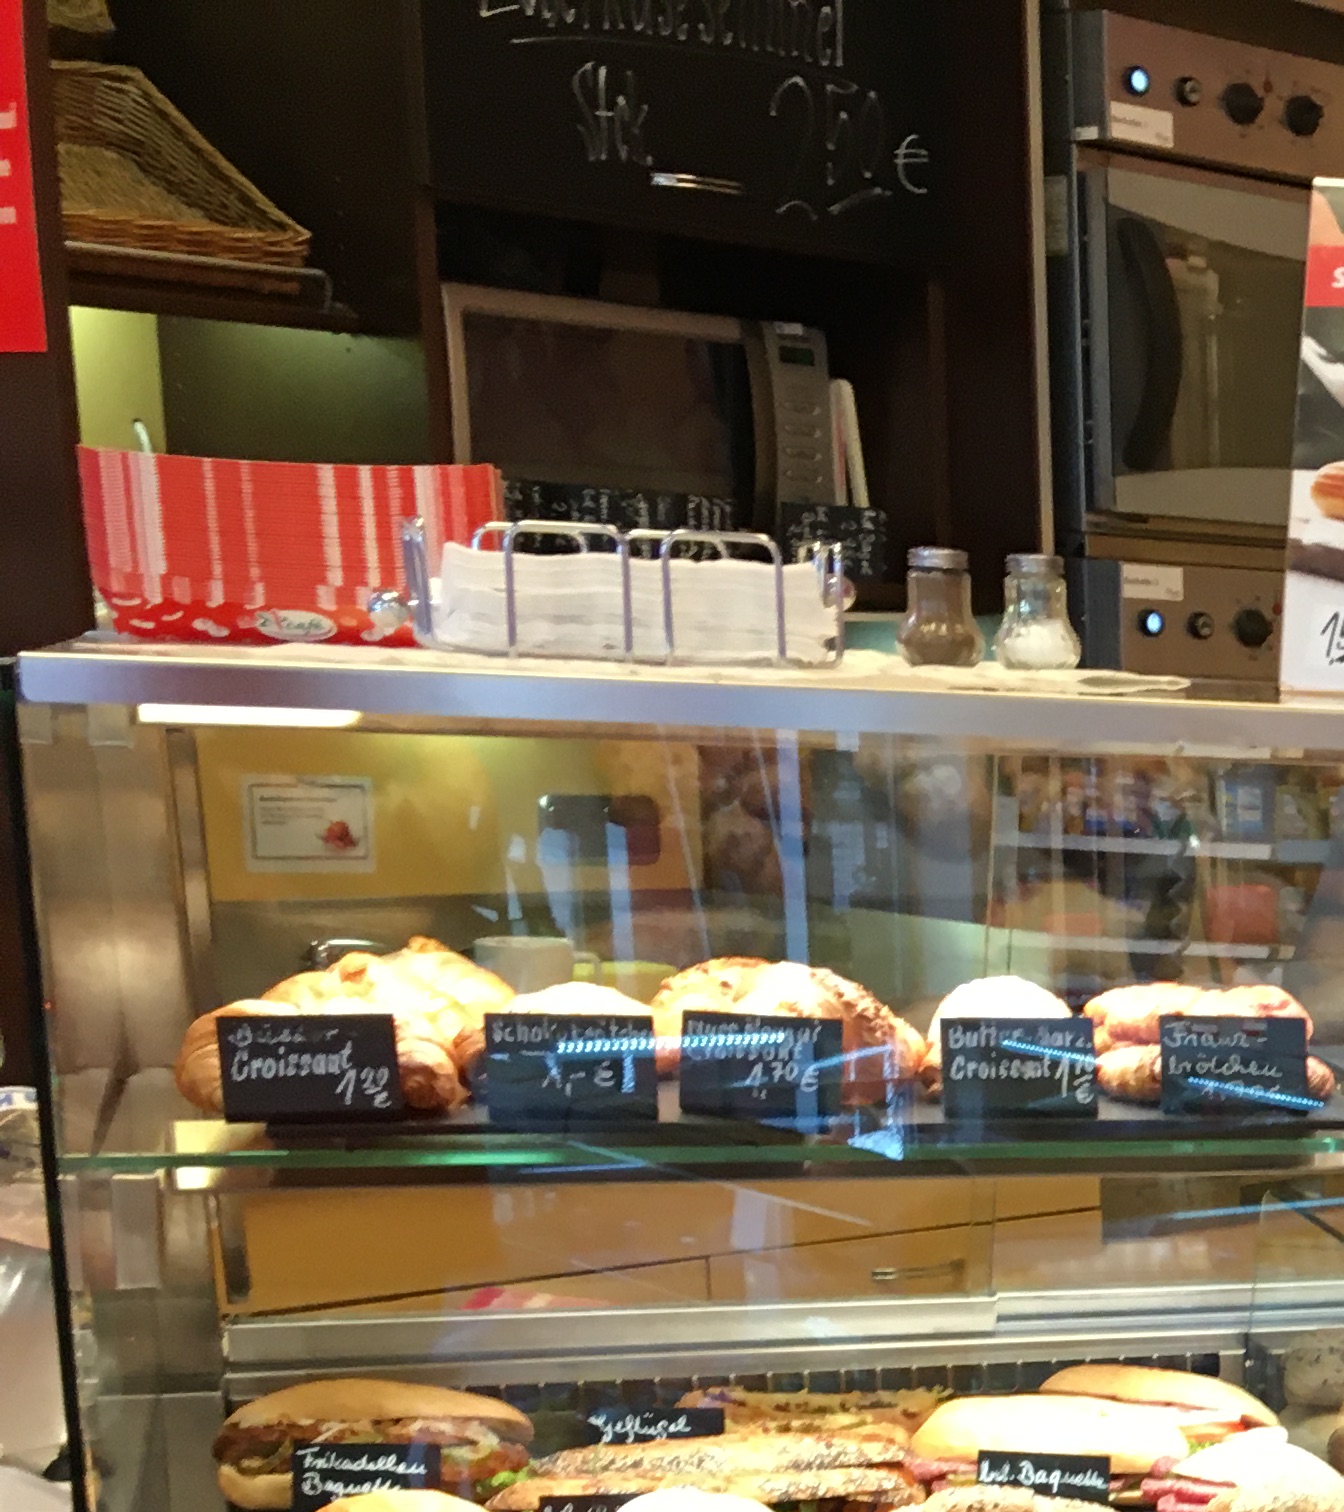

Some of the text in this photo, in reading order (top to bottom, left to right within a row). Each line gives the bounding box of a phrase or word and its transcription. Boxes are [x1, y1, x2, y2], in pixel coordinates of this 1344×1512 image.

[894, 133, 930, 195] €
[231, 1040, 353, 1082] Croissant
[589, 1412, 693, 1443] Geflügel
[295, 1447, 428, 1476] Frikadellen
